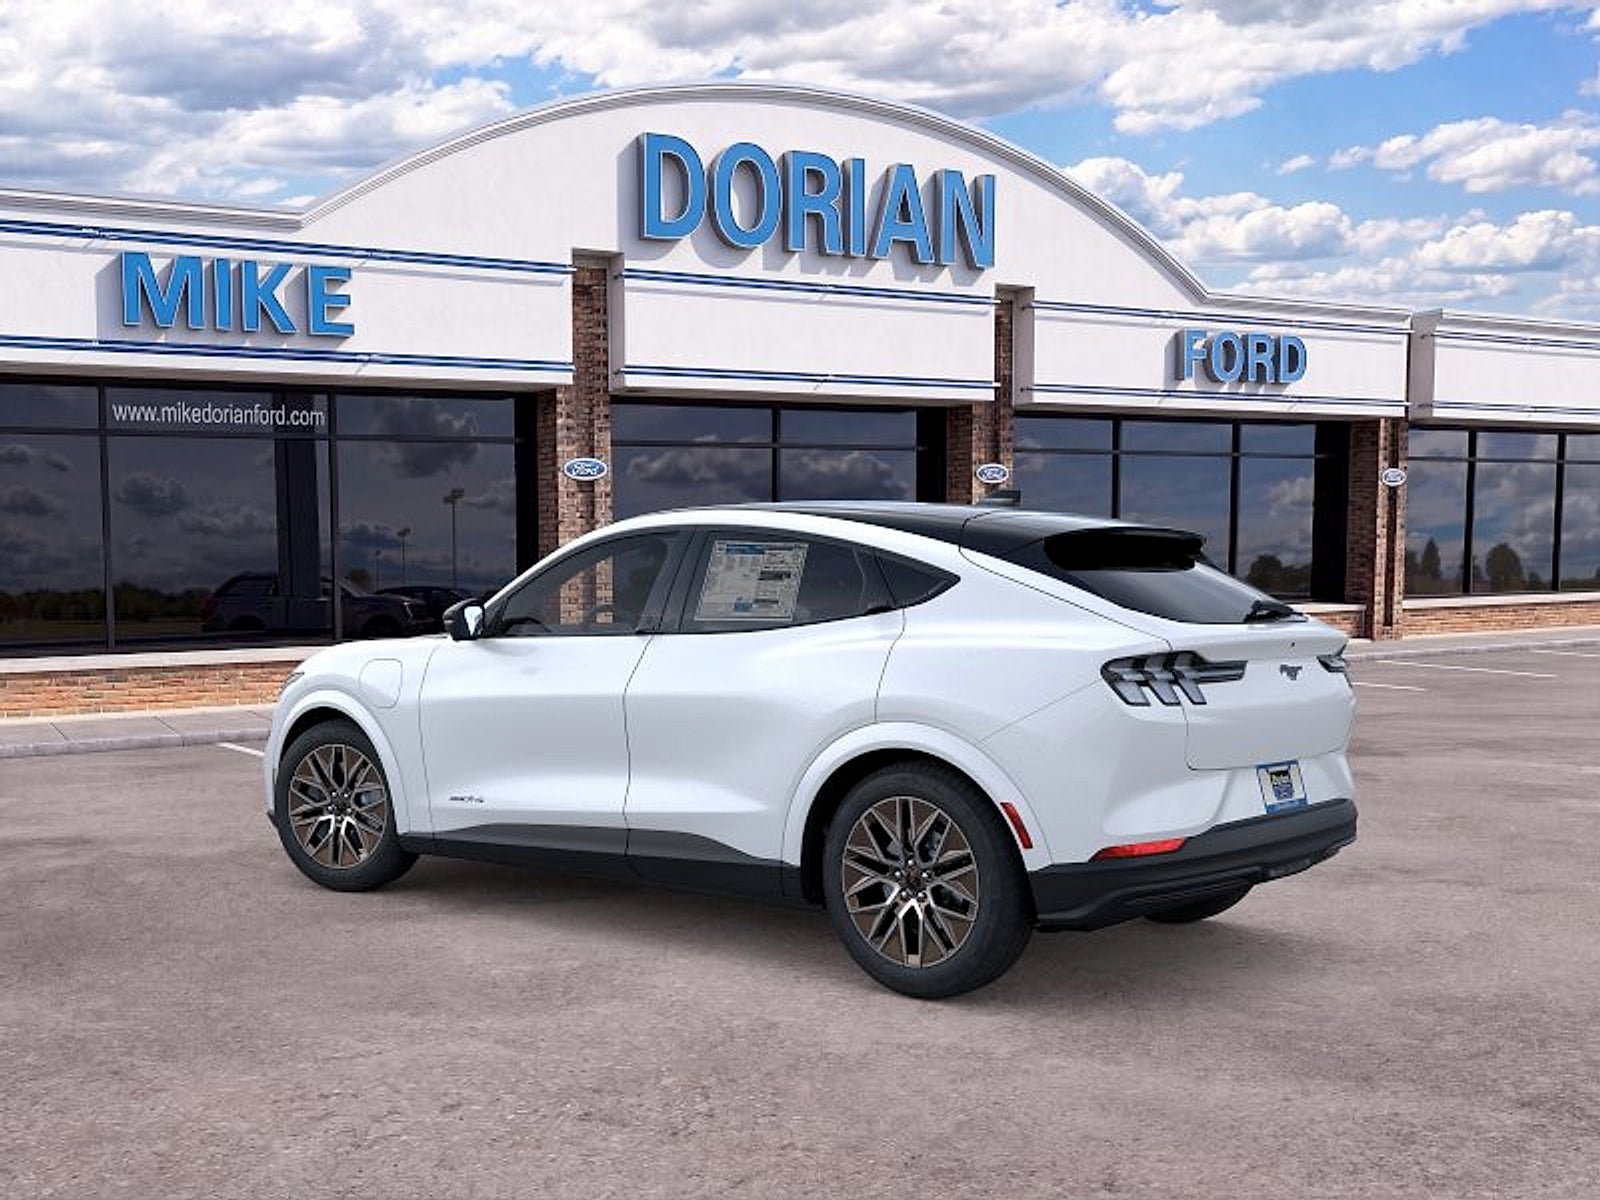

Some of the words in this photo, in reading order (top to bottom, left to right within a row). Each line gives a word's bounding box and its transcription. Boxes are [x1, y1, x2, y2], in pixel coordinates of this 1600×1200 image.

[639, 132, 996, 270] DORIAN
[121, 251, 355, 337] MIKE
[1177, 328, 1308, 384] FORD
[112, 402, 326, 427] www.mikedorianford.com
